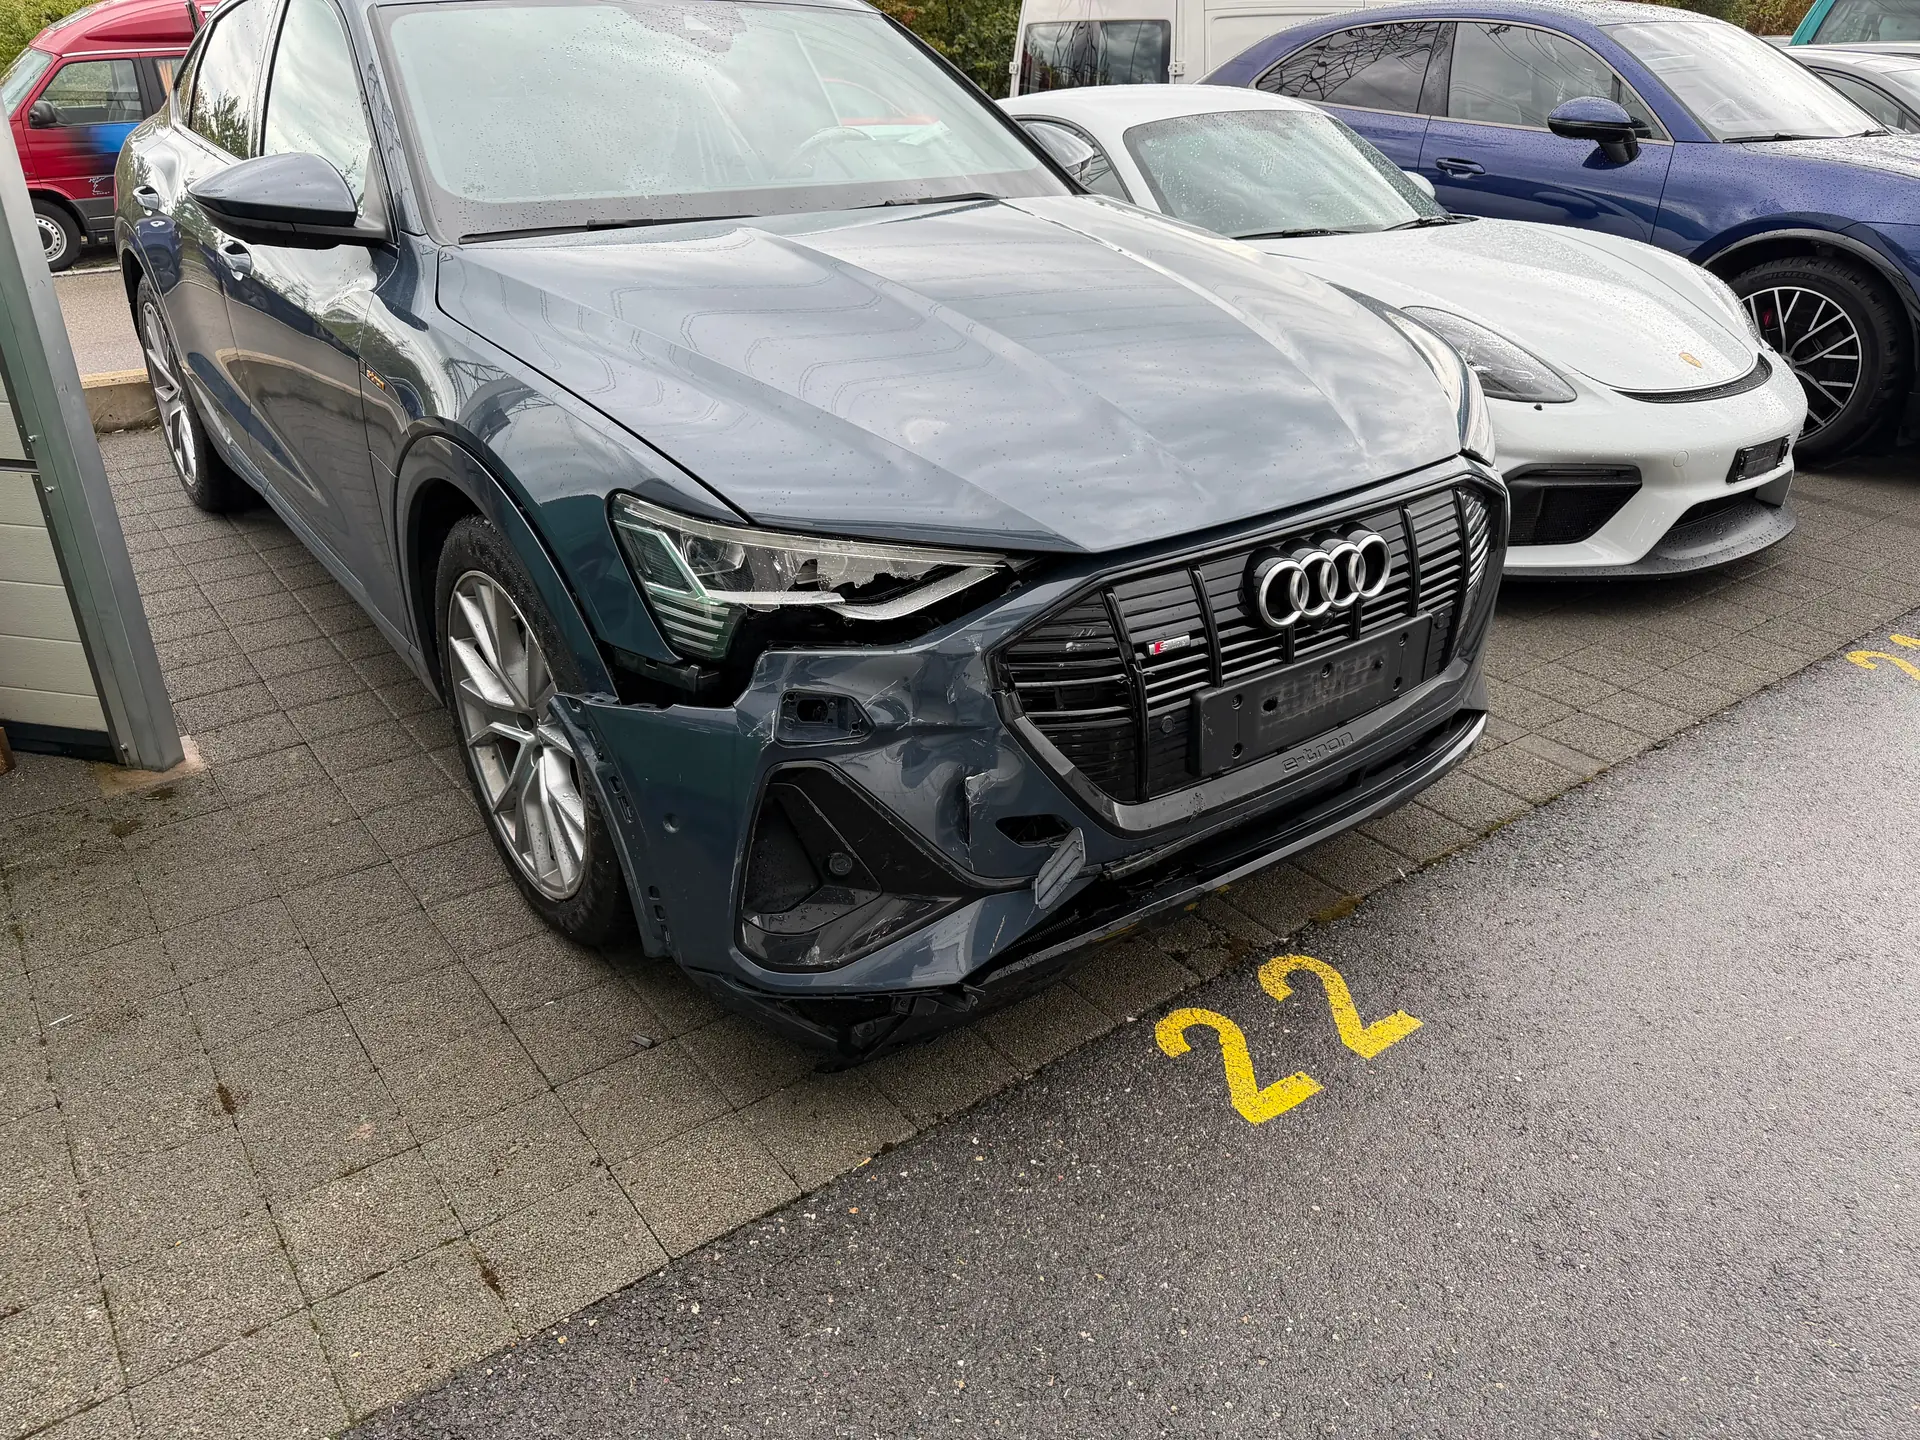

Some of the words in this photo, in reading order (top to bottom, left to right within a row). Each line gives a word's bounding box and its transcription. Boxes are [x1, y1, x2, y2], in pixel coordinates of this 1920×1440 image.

[1764, 271, 1818, 281] MICHELIN
[1281, 732, 1354, 772] e-tron
[1155, 954, 1424, 1126] 22
